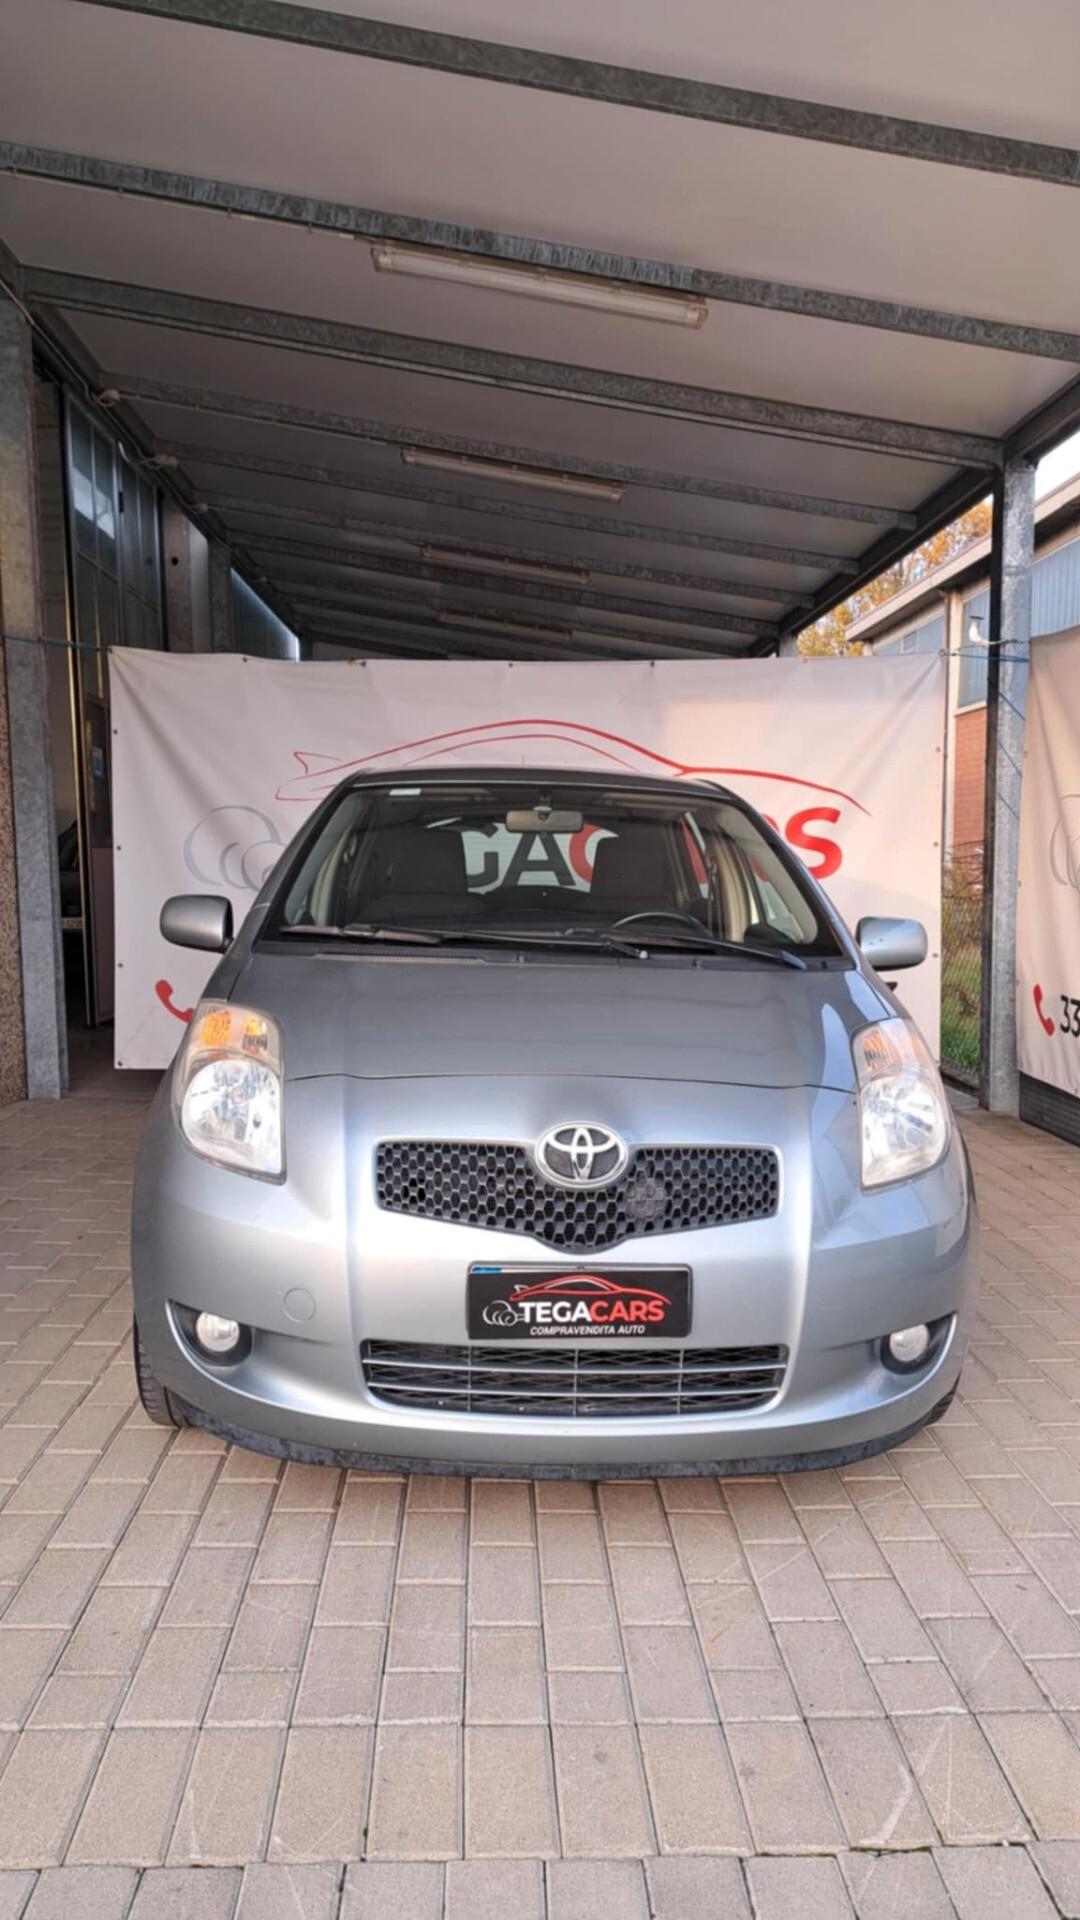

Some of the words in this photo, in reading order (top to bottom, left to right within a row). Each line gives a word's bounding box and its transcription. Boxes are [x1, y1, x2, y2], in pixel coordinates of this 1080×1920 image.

[519, 1300, 665, 1323] TEGACARS
[530, 1325, 616, 1336] COMPRAVENDITA
[618, 1324, 645, 1335] AUTO
